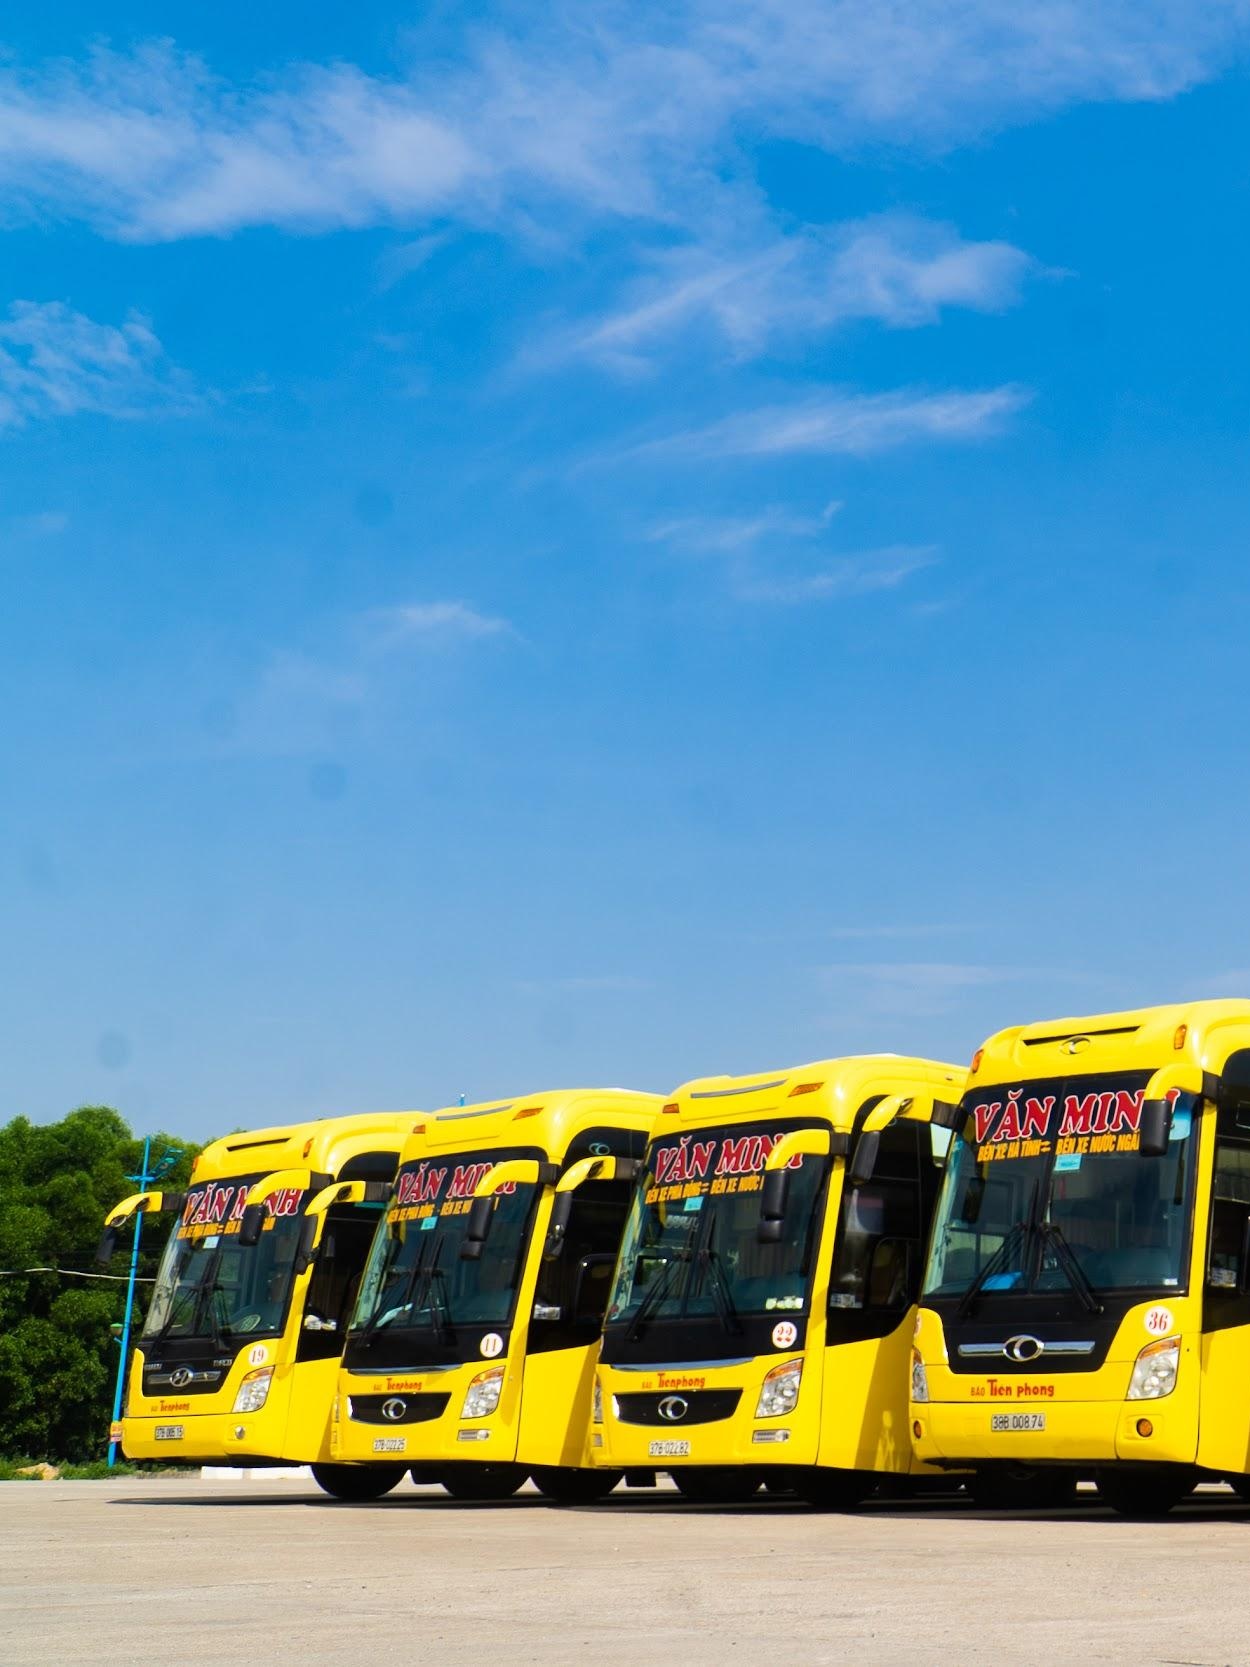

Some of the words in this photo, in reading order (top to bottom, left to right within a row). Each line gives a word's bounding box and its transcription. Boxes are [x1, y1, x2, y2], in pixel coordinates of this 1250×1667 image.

[974, 1088, 1056, 1143] VĂN
[1058, 1088, 1180, 1135] MIN
[1075, 1137, 1089, 1154] XE
[655, 1135, 716, 1183] VĂN
[397, 1161, 448, 1204] VĂN
[183, 1182, 234, 1226] VĂN
[1149, 1311, 1168, 1331] 36
[776, 1326, 793, 1343] 22
[485, 1338, 497, 1352] 11
[251, 1349, 265, 1363] 19
[1017, 1382, 1055, 1398] phong
